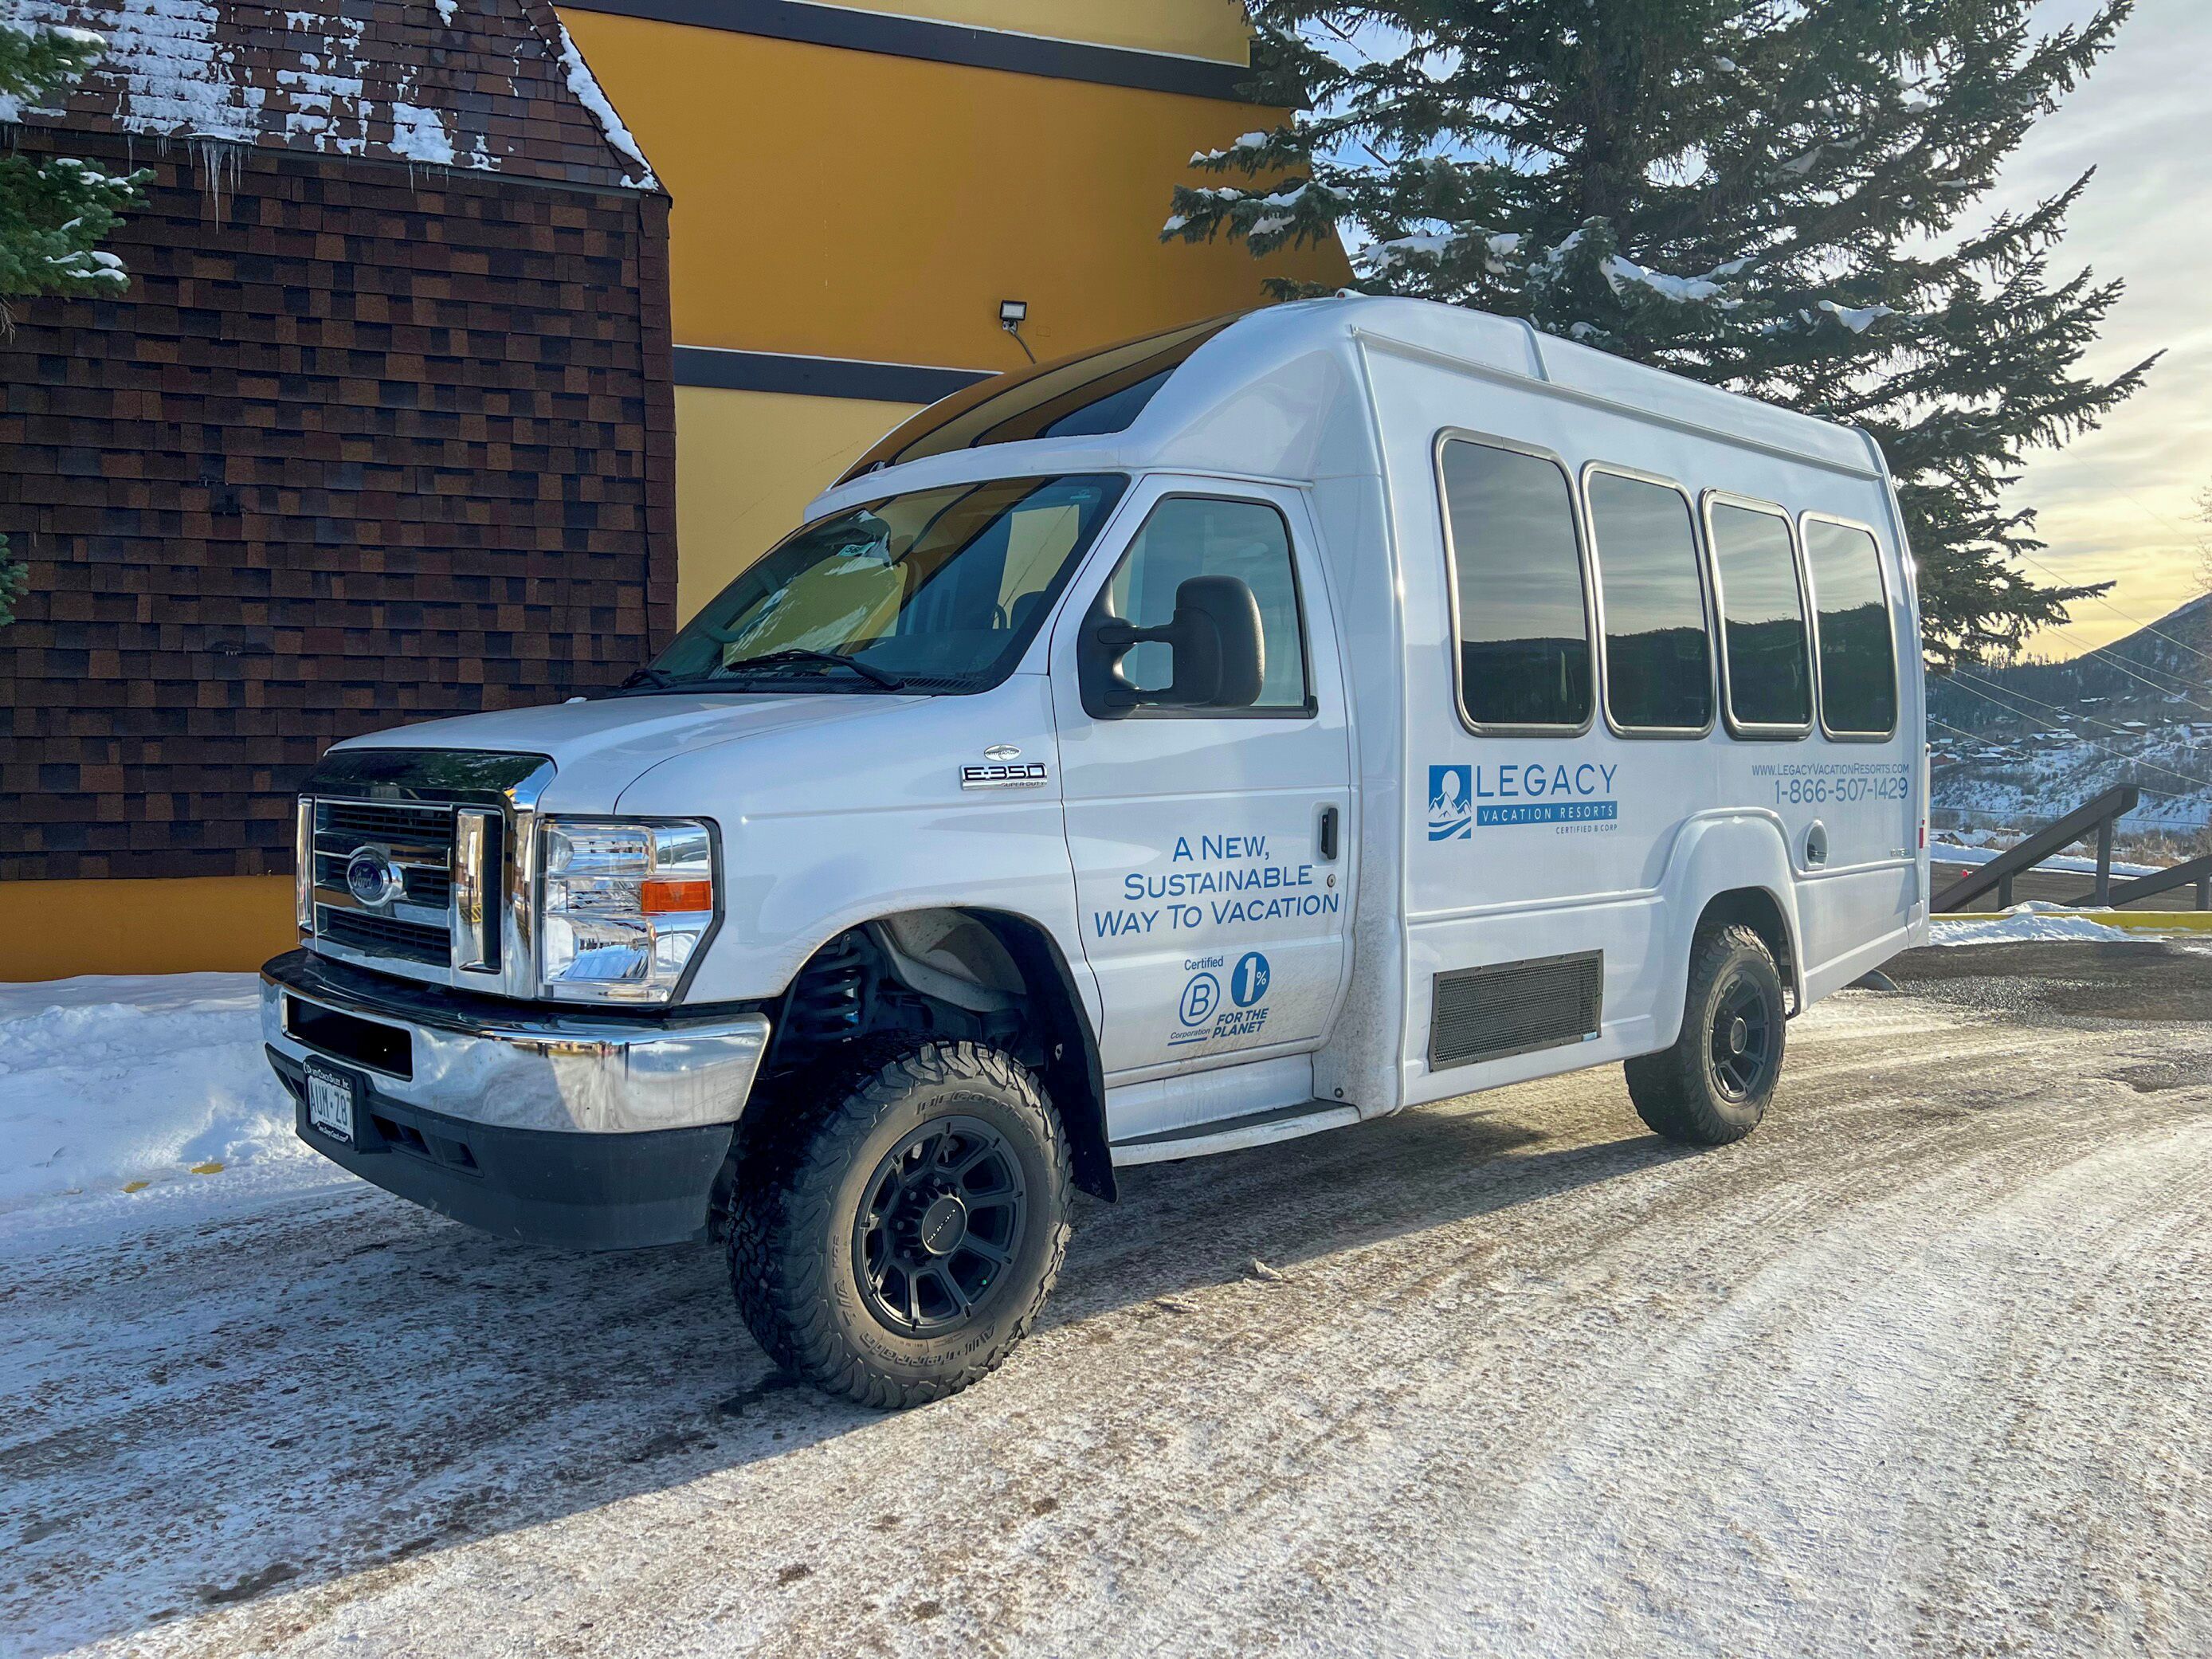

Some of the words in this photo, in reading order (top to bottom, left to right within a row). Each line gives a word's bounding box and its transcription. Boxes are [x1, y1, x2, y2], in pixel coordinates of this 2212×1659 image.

[963, 764, 1045, 781] E-350
[1476, 763, 1618, 798] LEGACY
[1775, 777, 1908, 805] 1-866-507-1429
[1482, 807, 1552, 822] VACATION
[1560, 805, 1614, 819] RESORTS
[1555, 825, 1592, 834] CERTIFIED
[1600, 823, 1618, 832] CORP
[1172, 836, 1194, 862] A
[1202, 834, 1270, 860] NEW,
[1124, 865, 1313, 900] SUSTAINABLE
[1094, 910, 1159, 938] WAY
[1167, 904, 1202, 930] TO
[1210, 893, 1339, 925] VACATION
[1184, 955, 1224, 971] Certified
[1188, 982, 1210, 1018] B
[1216, 1010, 1245, 1026] FOR
[1245, 1007, 1269, 1021] THE
[1170, 1026, 1211, 1041] Corporation
[1211, 1020, 1265, 1039] PLANET
